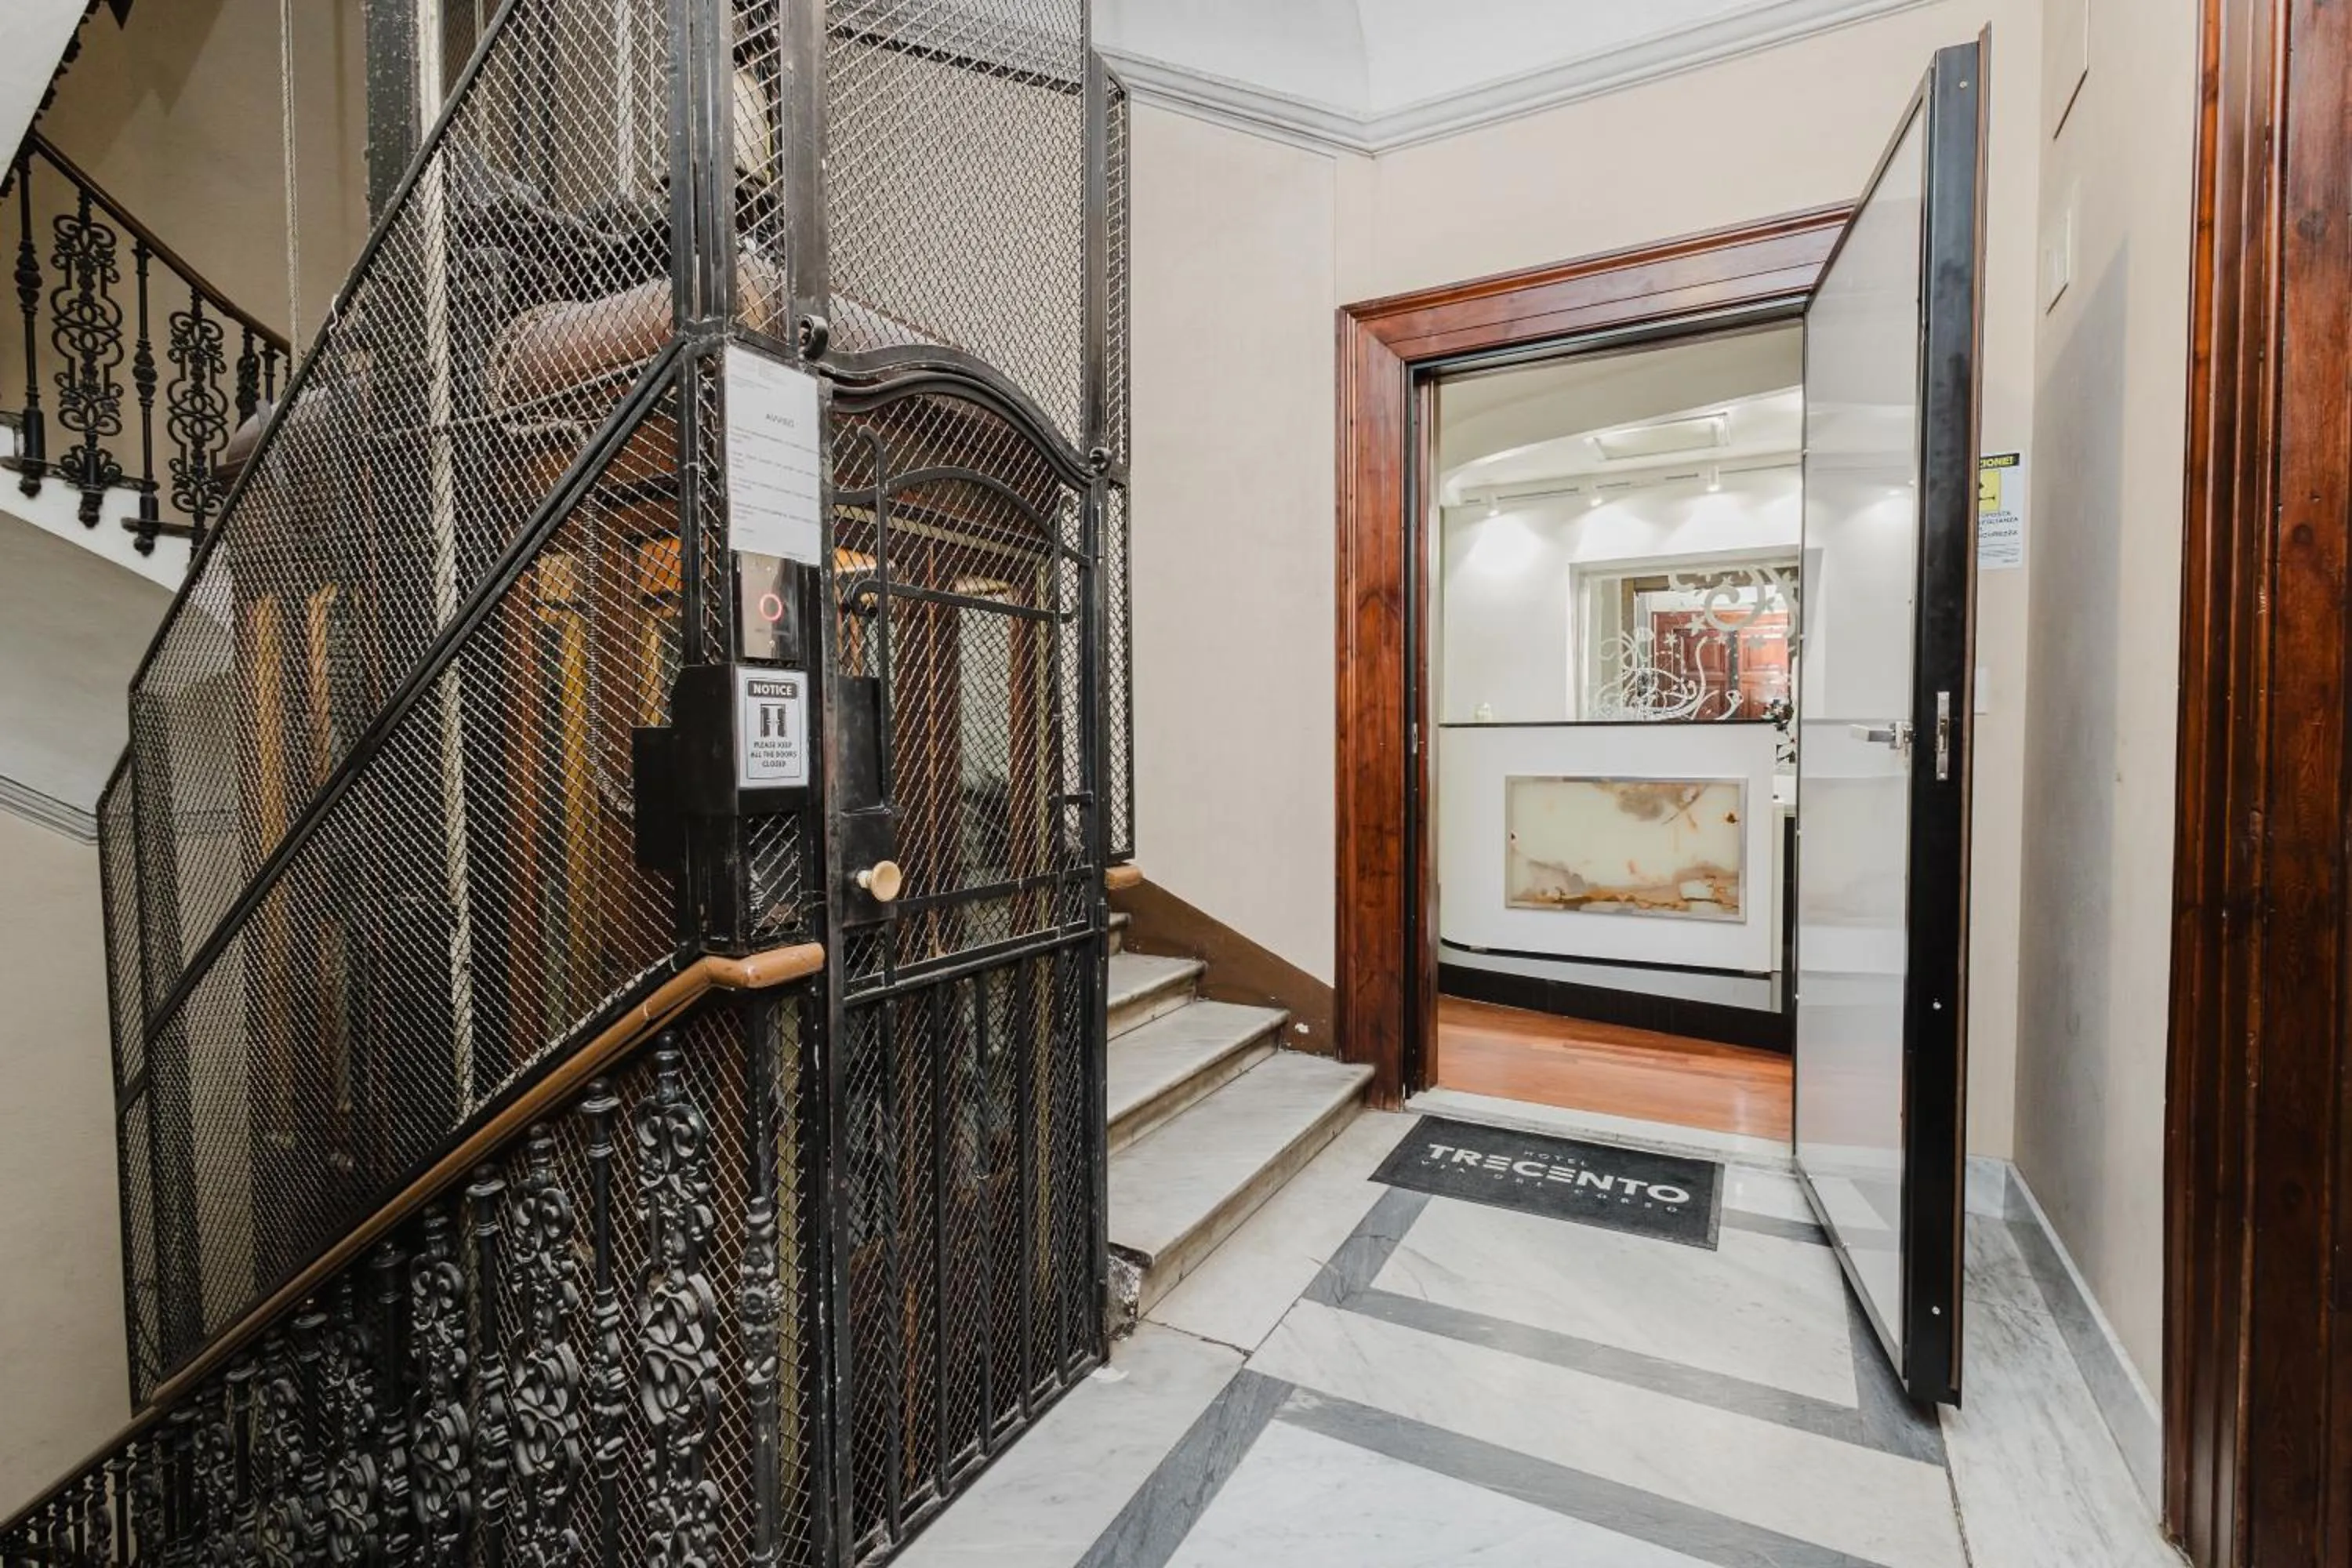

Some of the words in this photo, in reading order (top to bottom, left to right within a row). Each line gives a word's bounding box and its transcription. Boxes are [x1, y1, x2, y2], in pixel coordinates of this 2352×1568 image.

[753, 683, 793, 695] NOTICE
[1523, 1150, 1587, 1167] HOTEL
[1428, 1143, 1690, 1203] TRECENTO
